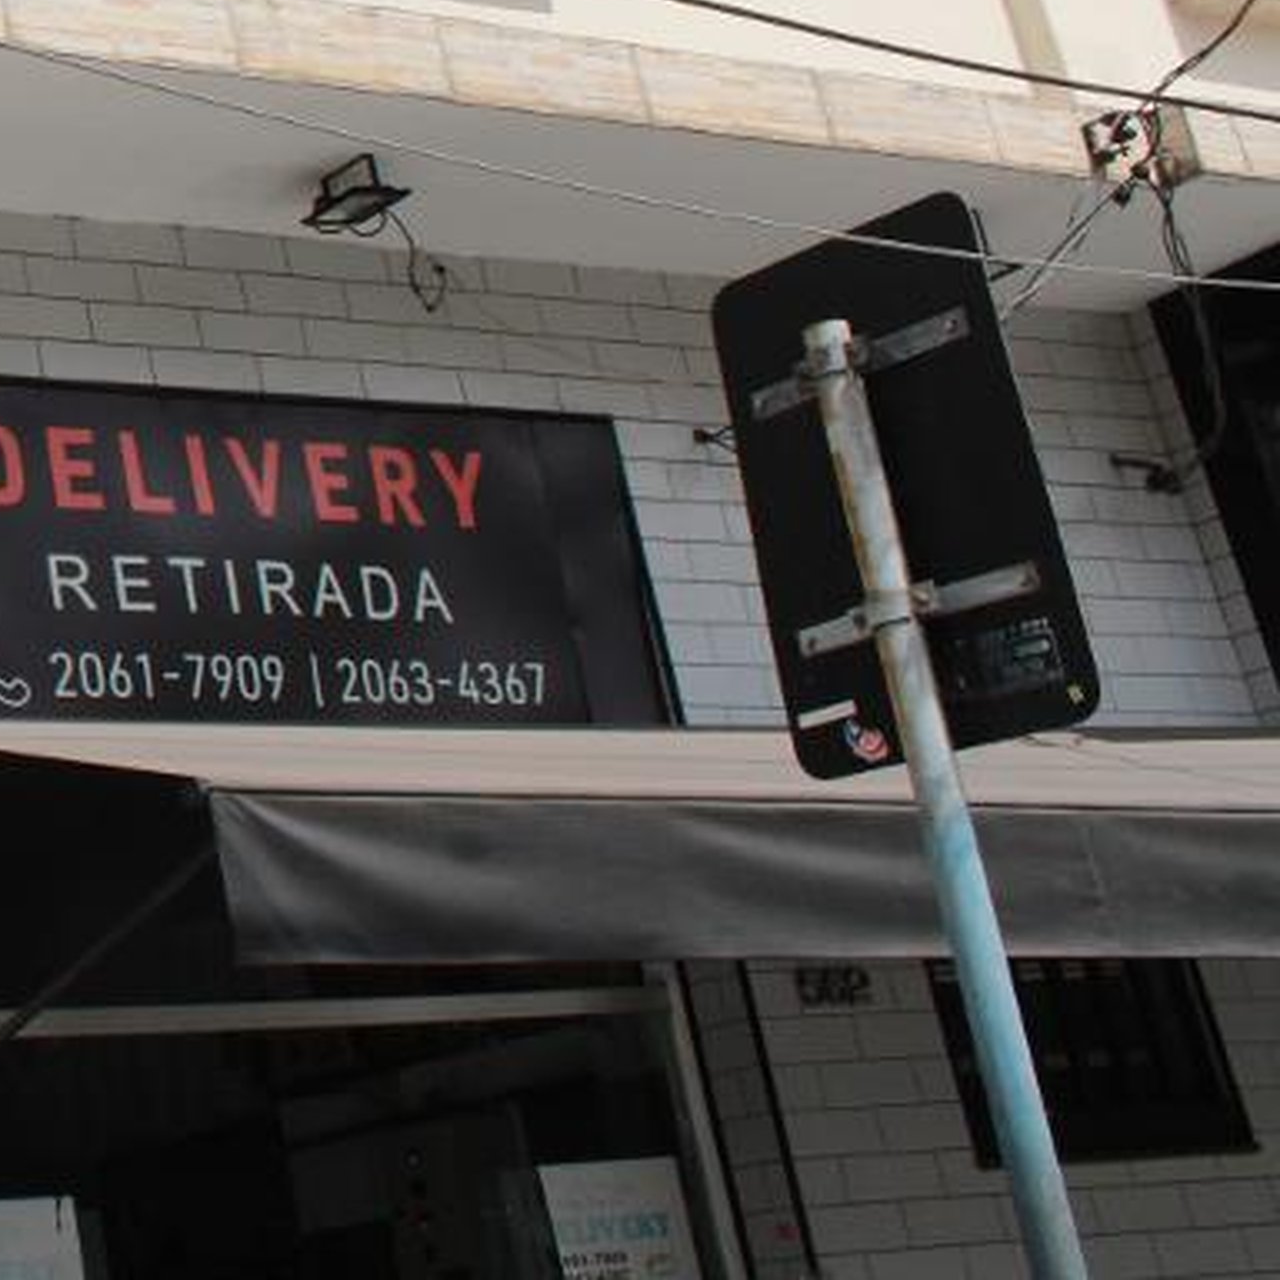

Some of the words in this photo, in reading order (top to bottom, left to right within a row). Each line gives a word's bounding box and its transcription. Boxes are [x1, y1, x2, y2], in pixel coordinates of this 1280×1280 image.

[47, 553, 453, 623] RETIRADA
[49, 652, 285, 701] 2061-7909
[338, 658, 546, 705] 2063-4367
